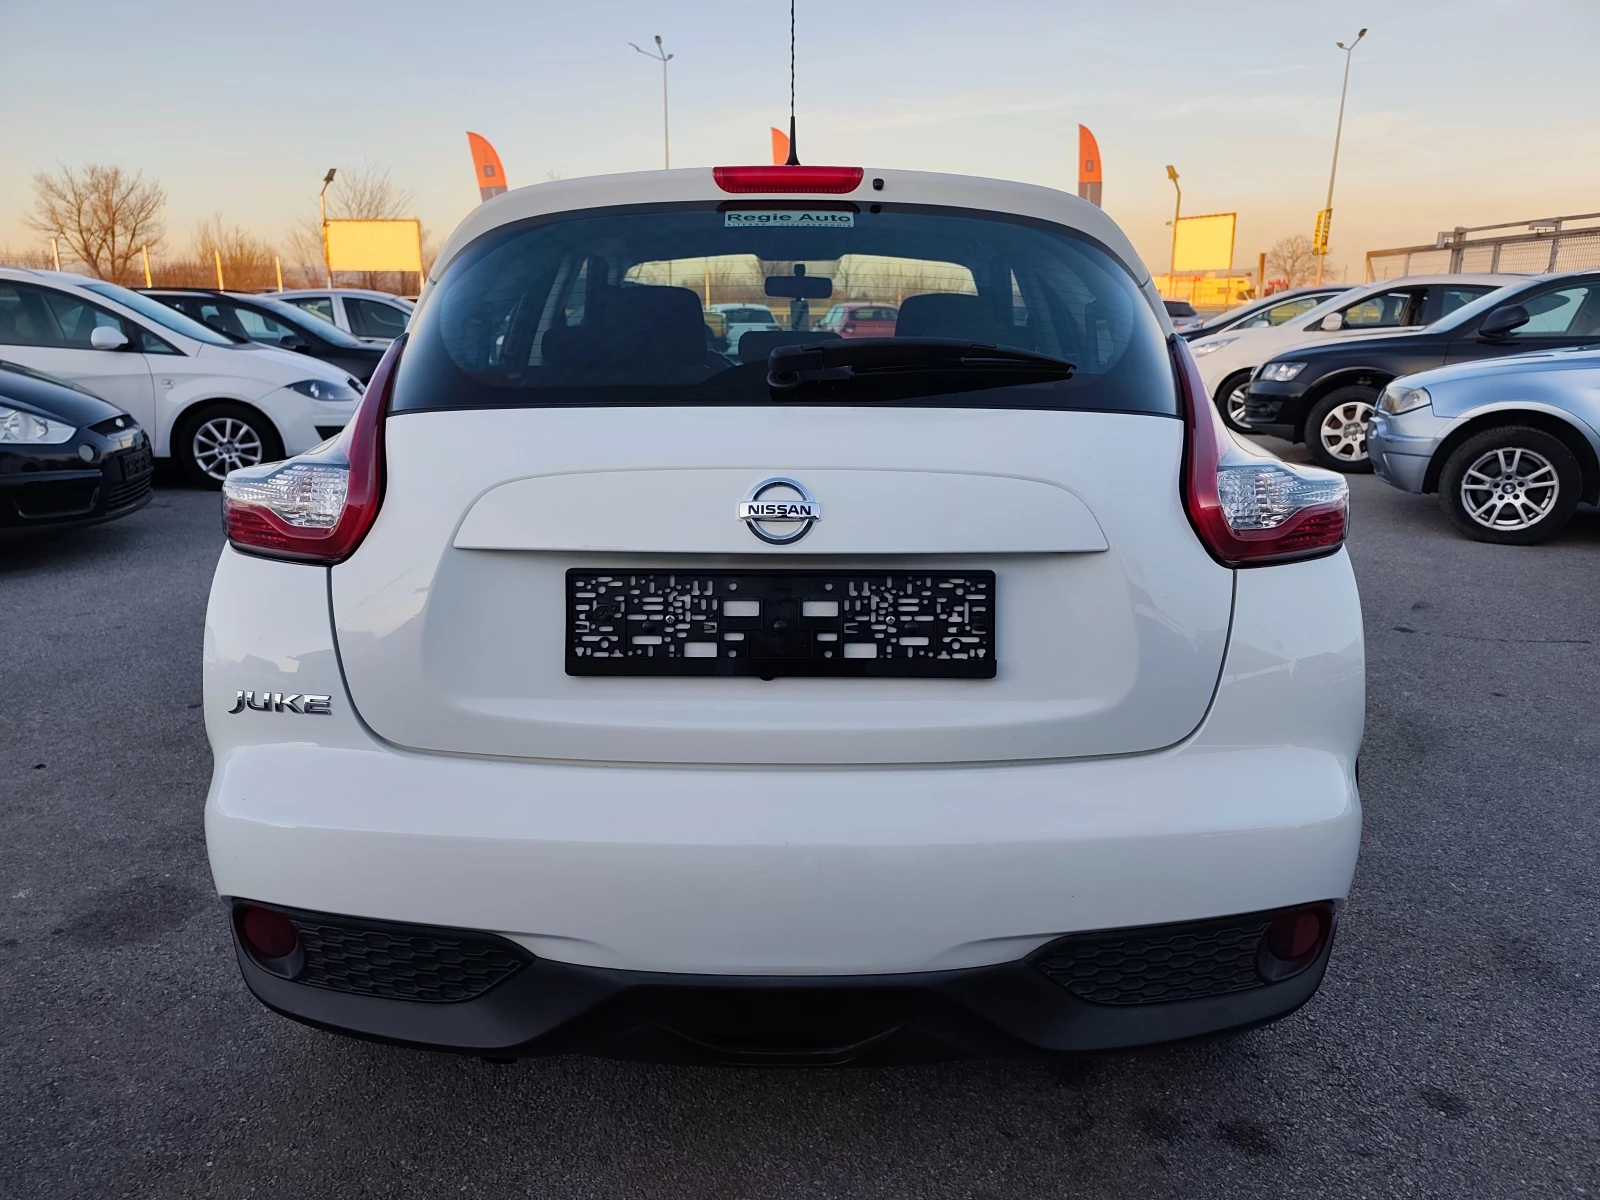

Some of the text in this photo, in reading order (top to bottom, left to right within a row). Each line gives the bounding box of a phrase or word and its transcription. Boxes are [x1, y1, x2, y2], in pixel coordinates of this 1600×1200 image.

[727, 213, 852, 223] Regie Auto
[748, 504, 812, 516] NISSAN
[228, 690, 332, 715] JUKE
